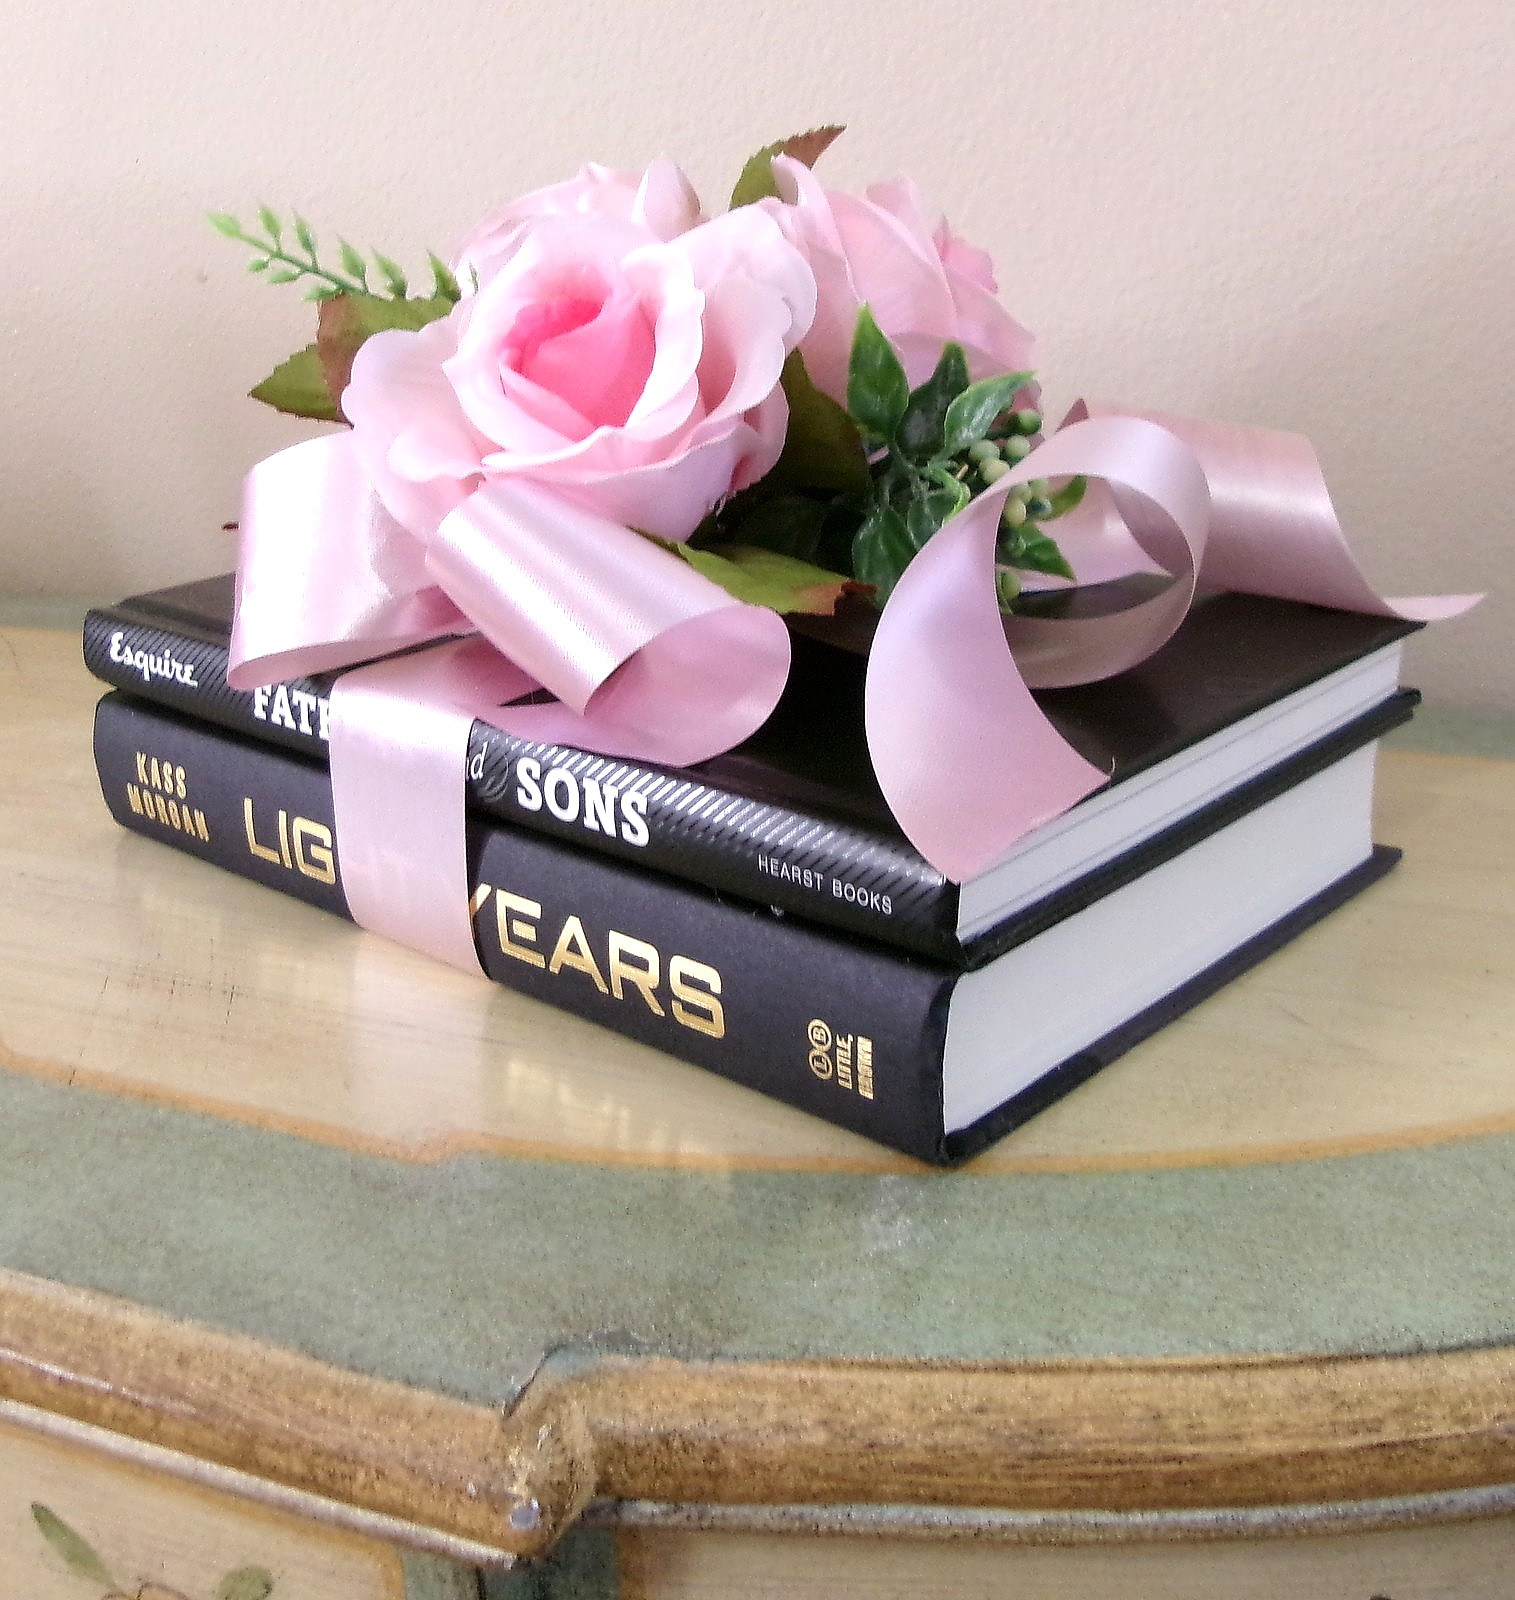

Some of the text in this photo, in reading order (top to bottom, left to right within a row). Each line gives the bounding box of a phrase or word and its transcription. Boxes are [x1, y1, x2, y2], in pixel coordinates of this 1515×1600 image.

[110, 632, 198, 687] Esquire
[136, 752, 187, 799] KASS
[466, 741, 488, 780] d
[516, 756, 650, 847] SONS
[126, 782, 209, 842] MORGAN
[758, 854, 892, 915] HEARST BOOKS
